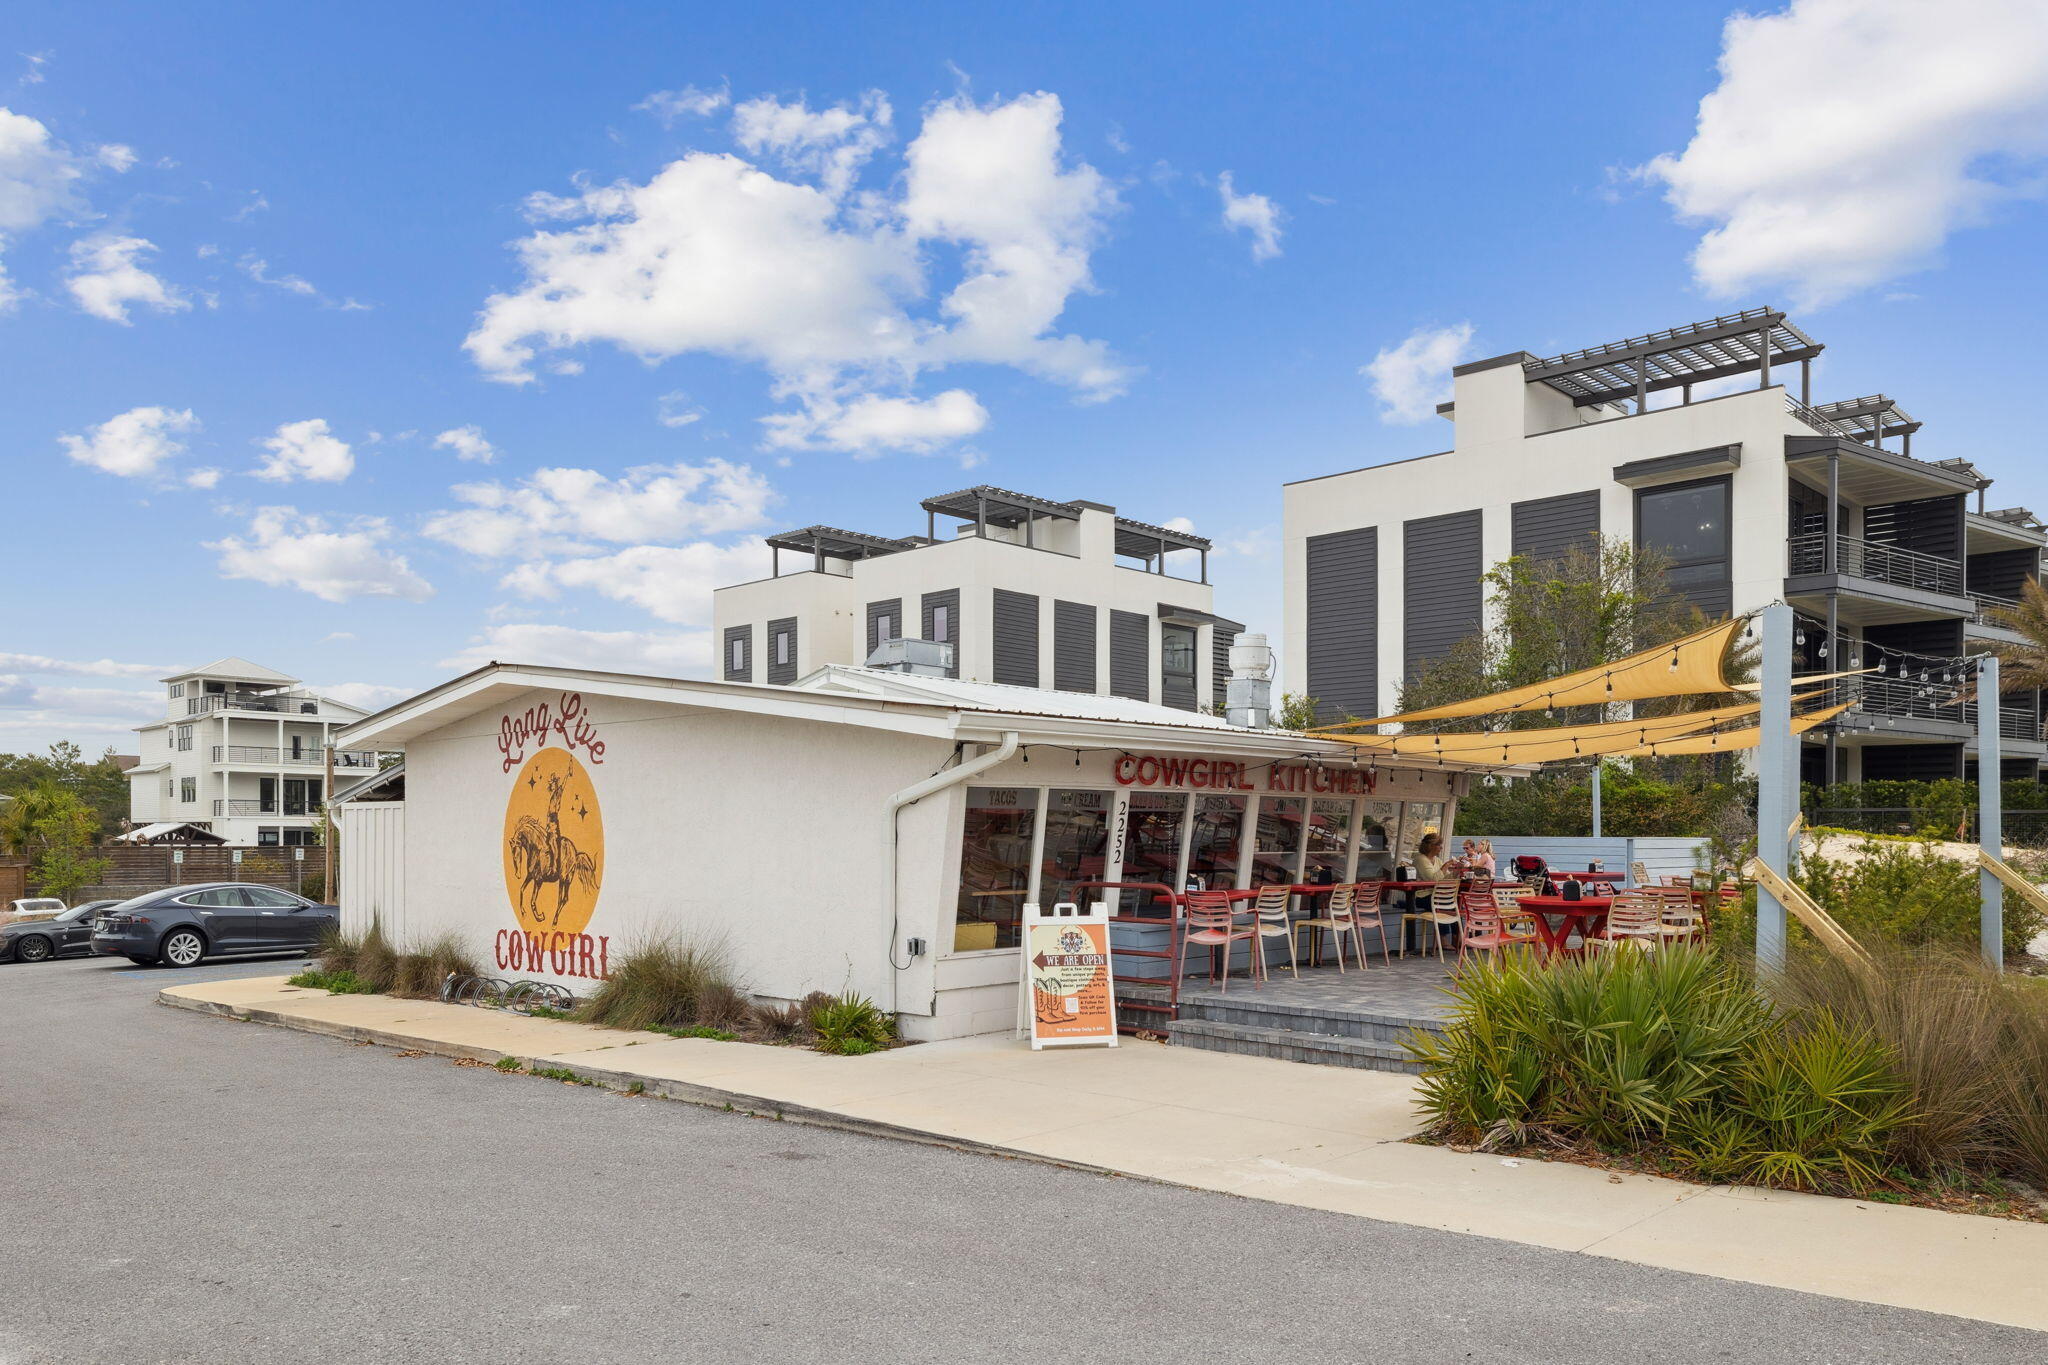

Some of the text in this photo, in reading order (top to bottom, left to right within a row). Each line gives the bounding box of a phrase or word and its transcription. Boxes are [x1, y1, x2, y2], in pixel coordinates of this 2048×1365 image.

[498, 692, 605, 773] Long Live
[989, 790, 1017, 806] TACOS
[1115, 755, 1377, 796] COWGIRL KITCHEN
[1113, 801, 1126, 863] 2252
[495, 929, 609, 981] COWGIRL
[1046, 954, 1104, 965] WE ARE OPEN
